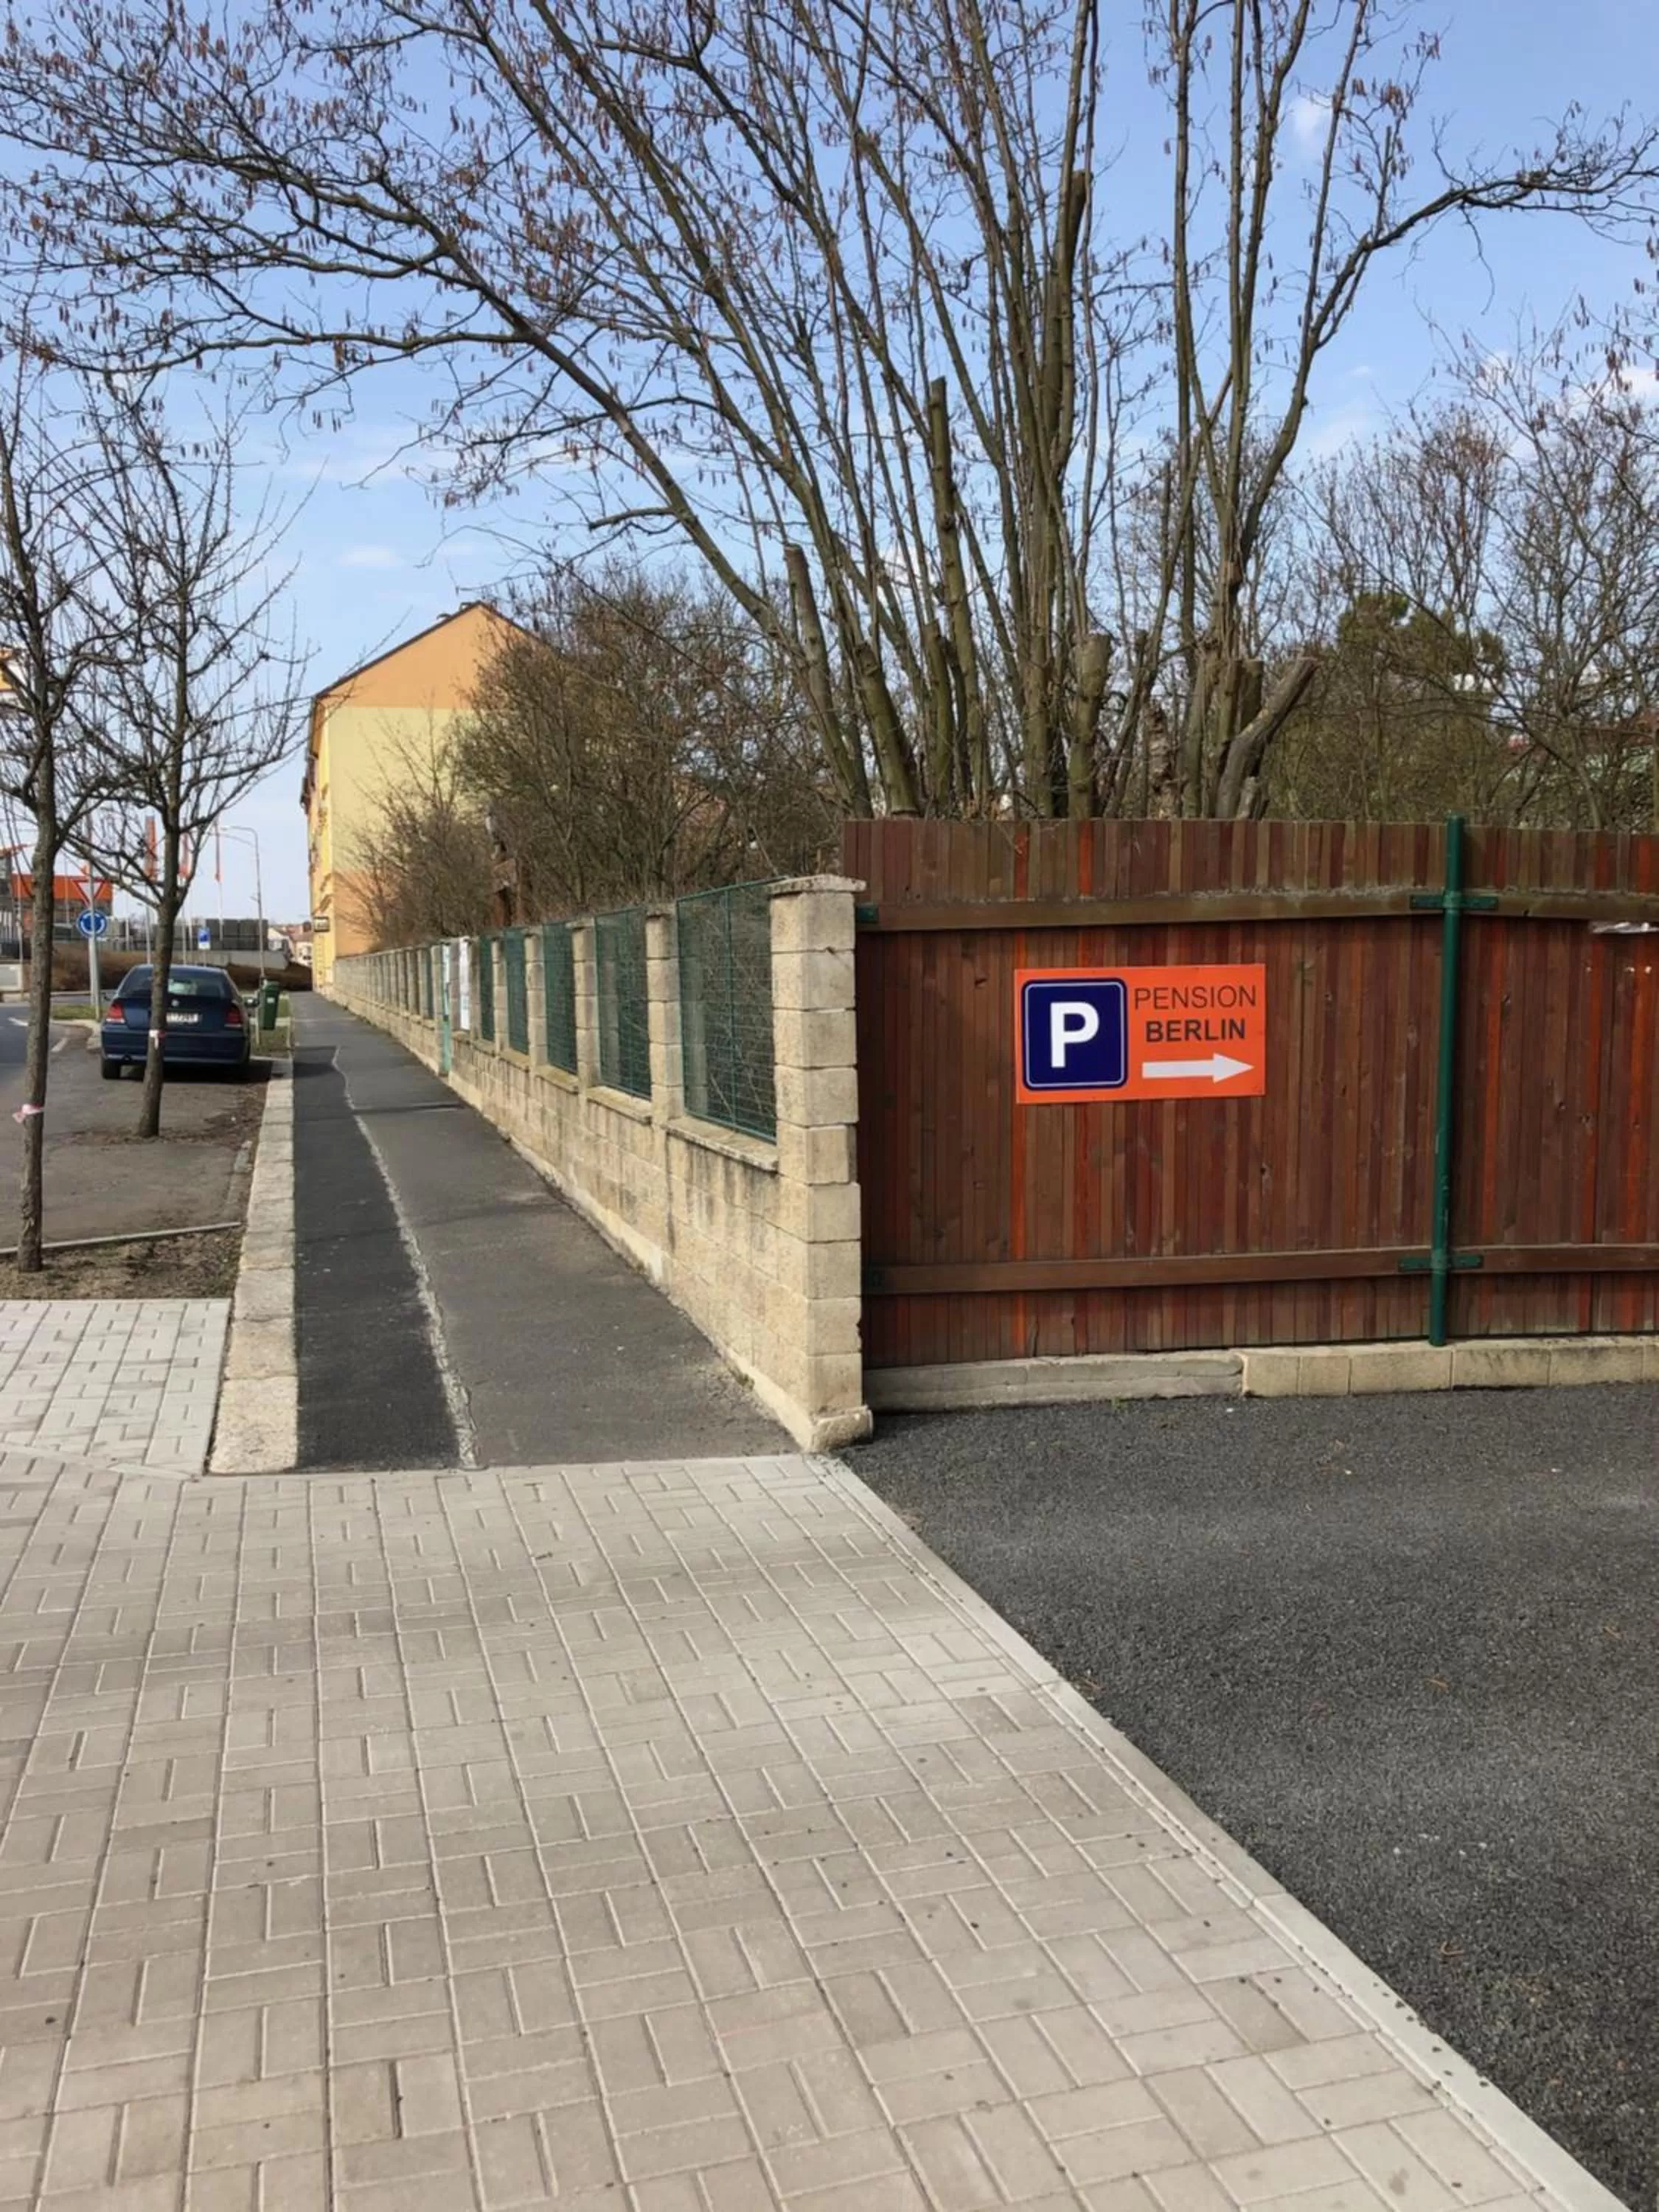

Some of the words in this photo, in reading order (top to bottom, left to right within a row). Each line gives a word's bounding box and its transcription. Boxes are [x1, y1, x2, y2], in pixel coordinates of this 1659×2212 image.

[1134, 985, 1256, 1009] PENSION
[1050, 1001, 1099, 1068] P
[1146, 1018, 1245, 1042] BERLIN
